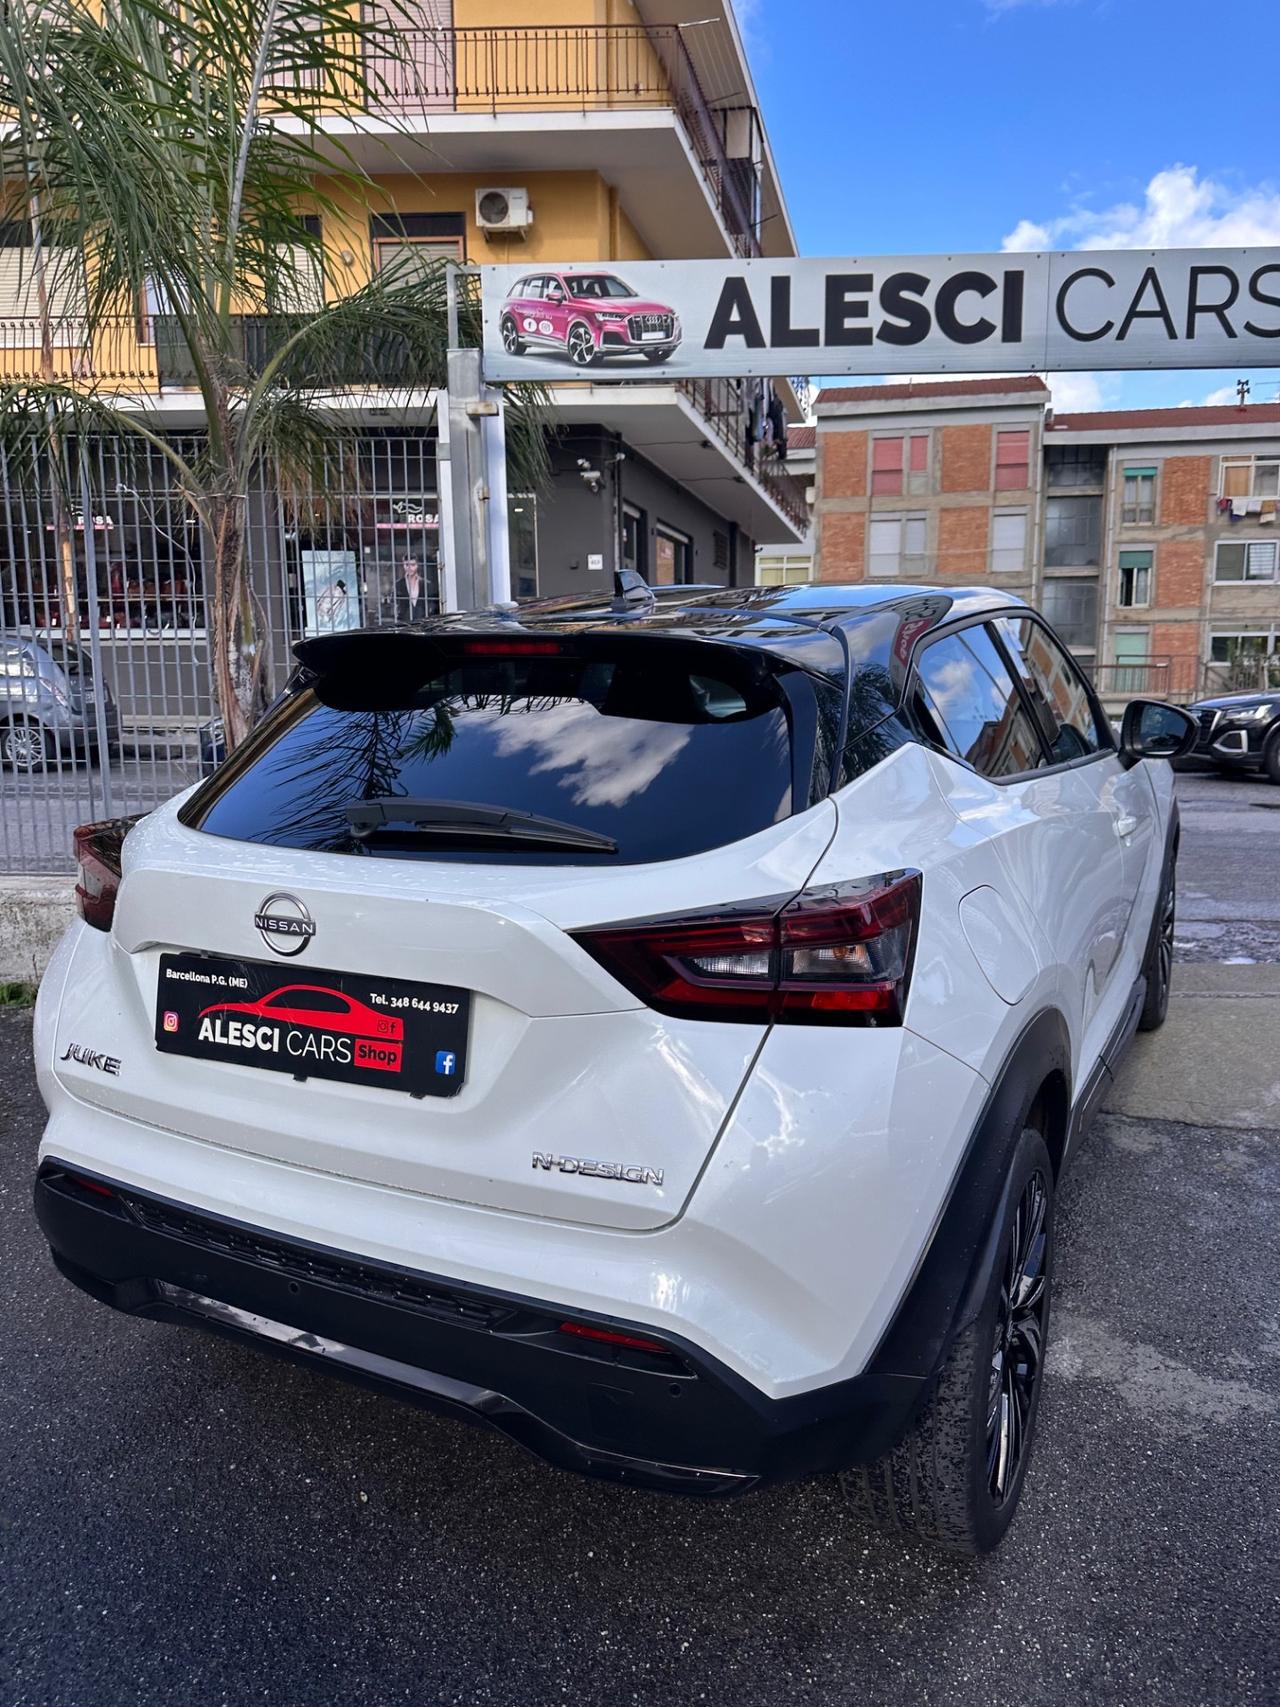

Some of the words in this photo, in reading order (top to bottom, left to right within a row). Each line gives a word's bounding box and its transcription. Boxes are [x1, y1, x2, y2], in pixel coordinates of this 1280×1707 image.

[703, 270, 1024, 349] ALESCI
[1056, 265, 1280, 341] CARS
[77, 515, 114, 525] RSA
[255, 917, 313, 934] NISSAN
[165, 968, 211, 984] Barcellona
[211, 976, 228, 986] P.G.
[228, 976, 249, 989] (ME)
[369, 993, 389, 1006] Tel.
[390, 997, 410, 1008] 348
[411, 999, 431, 1012] 644
[432, 1003, 459, 1015] 9437
[198, 1017, 281, 1053] ALESCI
[286, 1030, 352, 1065] CARS
[357, 1044, 397, 1066] Shop
[60, 1042, 122, 1077] JUKE
[531, 1151, 665, 1187] N-DESIGN
